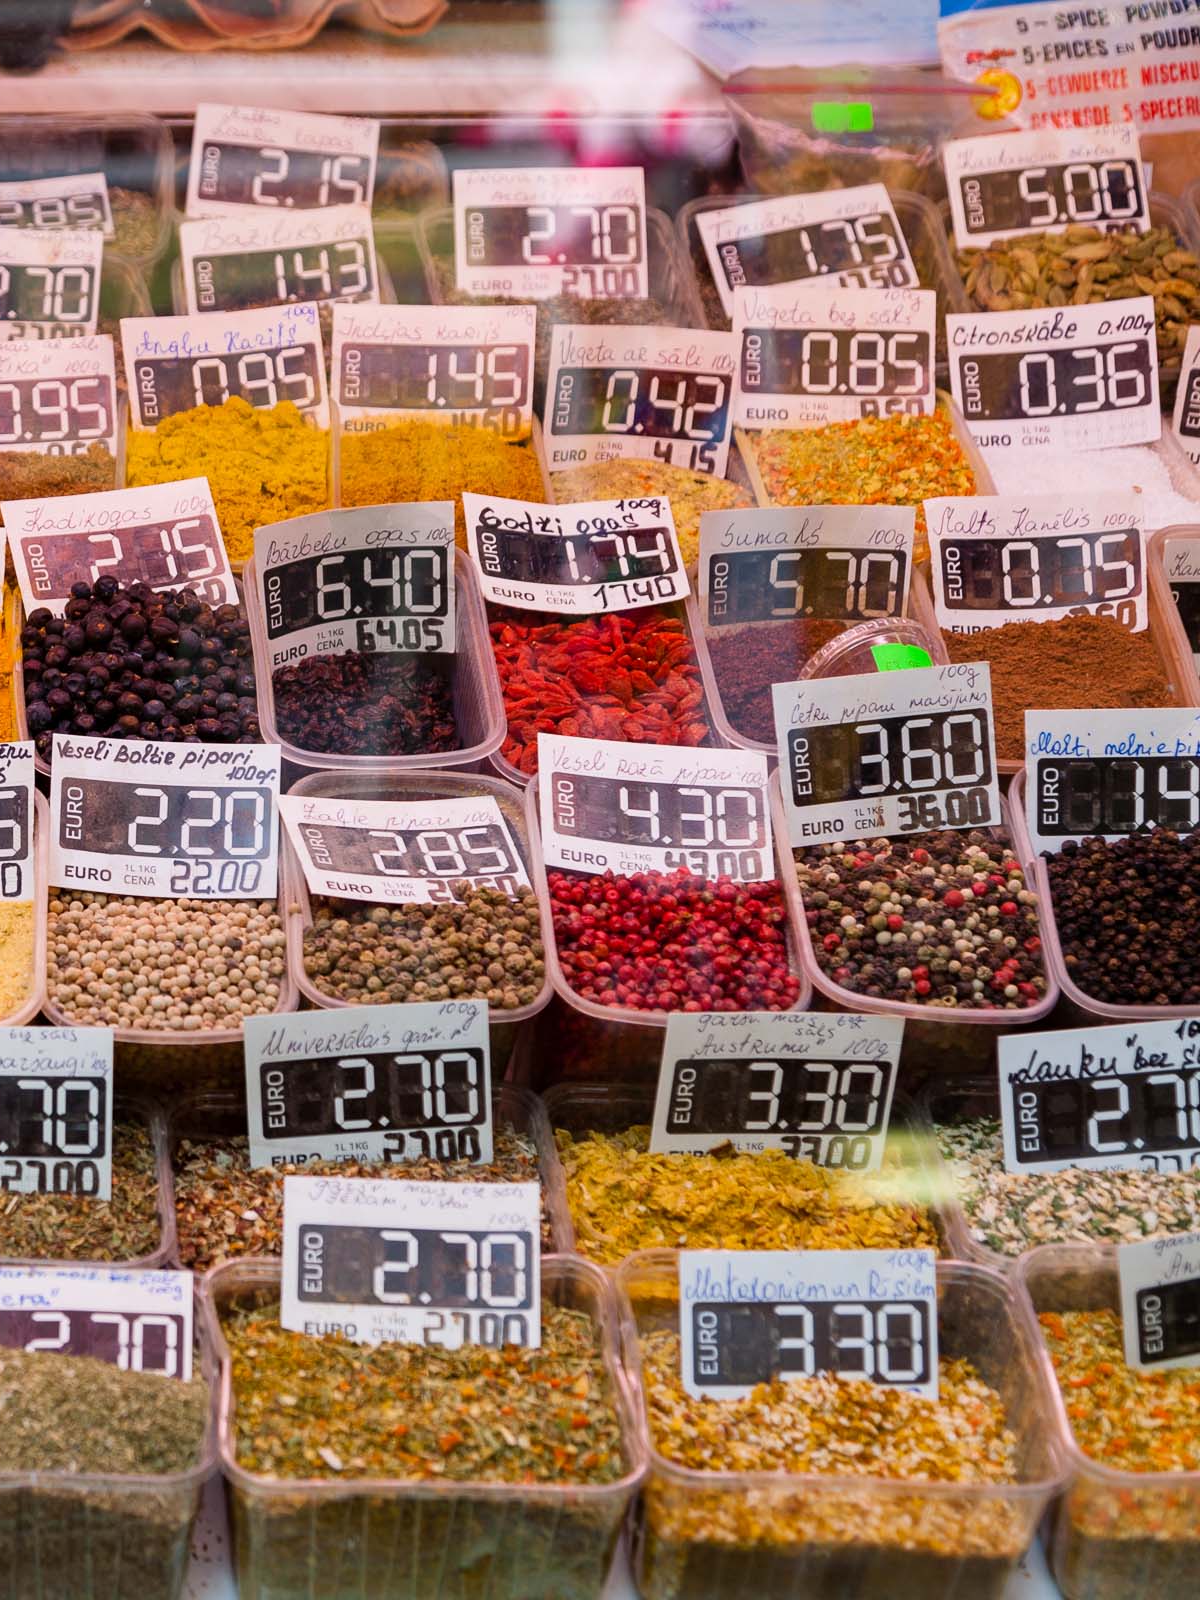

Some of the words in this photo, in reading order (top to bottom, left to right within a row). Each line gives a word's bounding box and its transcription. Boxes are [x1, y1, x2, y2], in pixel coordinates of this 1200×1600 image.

[1016, 17, 1029, 33] 5
[1056, 7, 1109, 29] SPICE
[1116, 42, 1135, 54] EN
[202, 147, 220, 195] EURO
[253, 148, 363, 207] 2.15
[1019, 162, 1137, 225] 5.00
[965, 179, 984, 227] EURO
[471, 212, 485, 259] EURO
[522, 206, 637, 264] 2.70
[800, 214, 899, 275] 1.75
[197, 261, 215, 306] EURO
[275, 241, 367, 300] 1.43
[471, 280, 513, 291] EURO
[741, 298, 817, 326] Vegeta
[345, 350, 362, 400] EURO
[426, 346, 524, 408] 1.45
[745, 334, 762, 386] EURO
[801, 331, 925, 394] 0.85
[1018, 342, 1147, 415] 0.36
[556, 375, 574, 427] EURO
[602, 370, 725, 440] 0.42
[746, 407, 789, 421] EURO
[963, 361, 981, 414] EURO
[1021, 434, 1051, 446] CENA
[565, 530, 669, 584] 1.74
[948, 546, 963, 600] EURO
[1001, 532, 1136, 606] 0.75
[270, 575, 283, 630] EURO
[315, 550, 441, 620] 6.40
[492, 585, 536, 602] EURO
[592, 576, 678, 610] 17.40
[712, 561, 730, 616] EURO
[770, 552, 898, 618] 5.70
[272, 643, 308, 666] EURO
[356, 617, 445, 653] 64.05
[57, 741, 112, 760] Veseli
[114, 744, 176, 766] Baltie
[179, 750, 253, 770] pipari
[794, 737, 813, 796] EURO
[854, 713, 983, 795] 3.60
[128, 787, 265, 855] 2.20
[557, 780, 575, 828] EURO
[619, 787, 758, 846] 4.30
[898, 786, 993, 832] 36.00
[65, 865, 111, 882] EURO
[170, 859, 262, 894] 22.00
[368, 828, 510, 876] 2.85
[561, 849, 607, 866] EURO
[124, 875, 155, 886] CENA
[267, 1070, 285, 1129] EURO
[334, 1052, 479, 1130] 2.70
[674, 1067, 697, 1124] EURO
[745, 1062, 883, 1131] 3.30
[1019, 1092, 1039, 1152] EURO
[303, 1232, 324, 1294] EURO
[373, 1229, 526, 1307] 2.70
[700, 1310, 718, 1375] EURO
